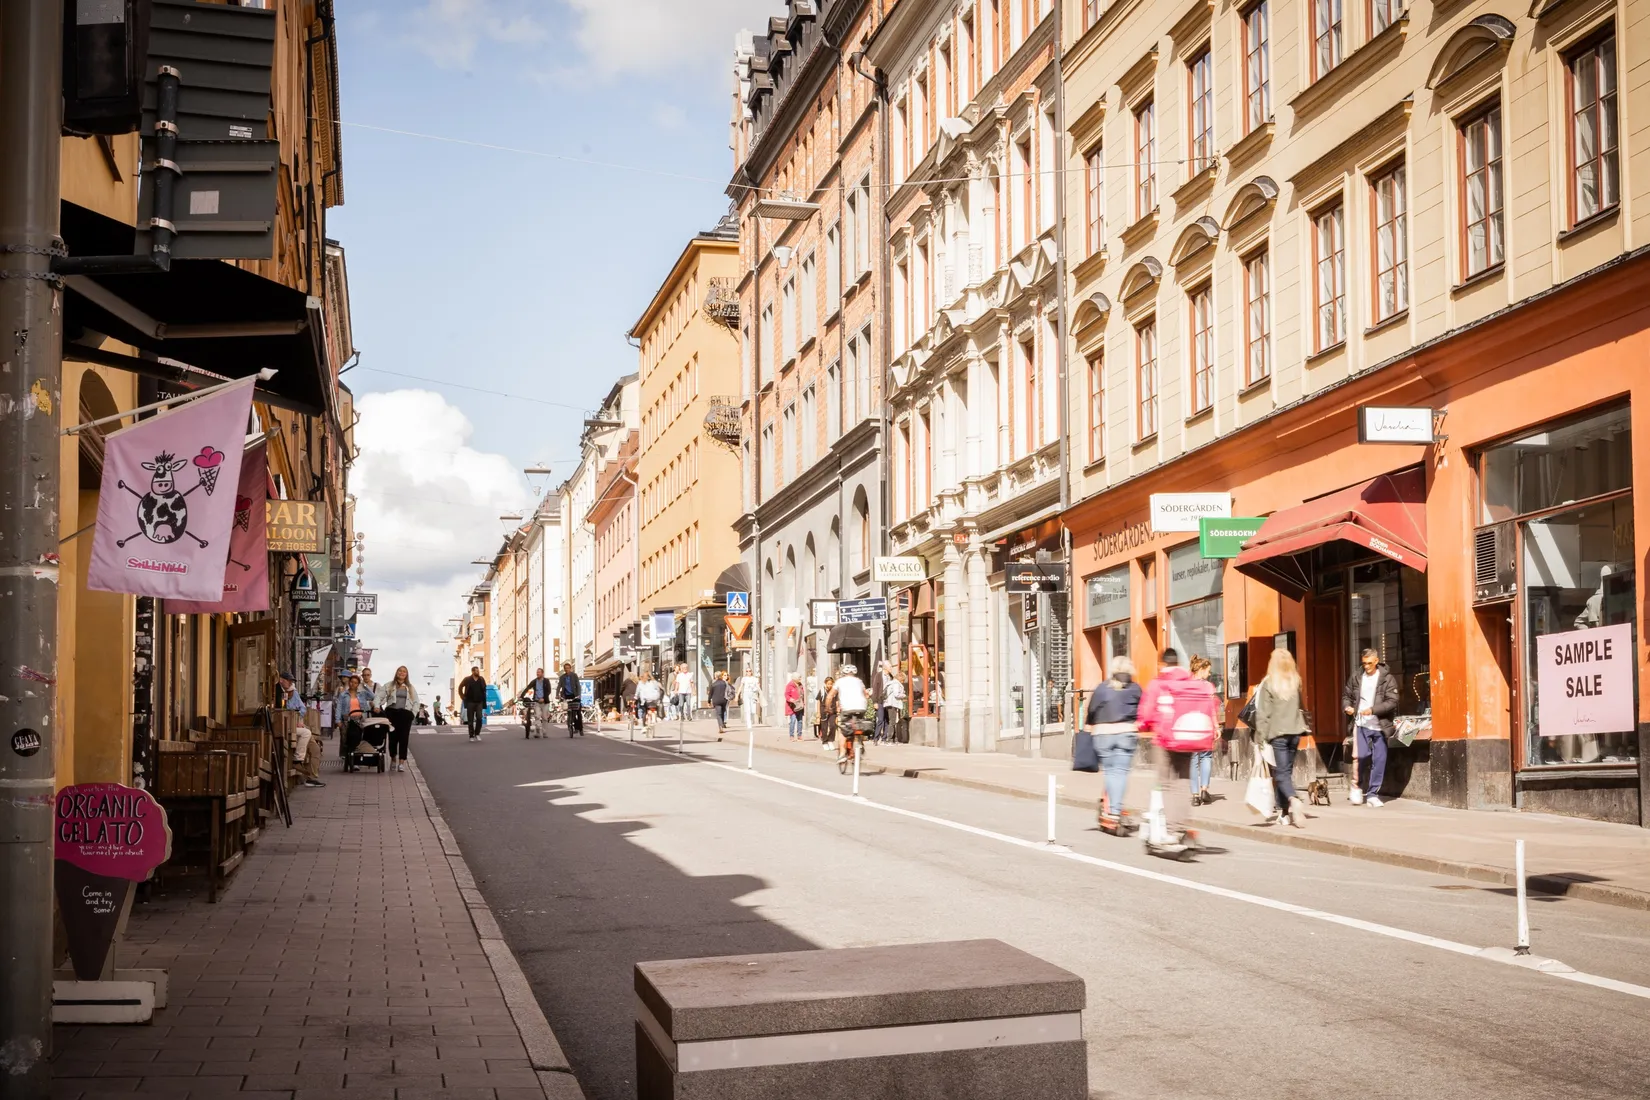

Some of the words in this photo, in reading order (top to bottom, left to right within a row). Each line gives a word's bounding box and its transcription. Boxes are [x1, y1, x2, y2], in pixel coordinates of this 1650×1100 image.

[1160, 503, 1223, 513] SÖDERGÅRDEN
[286, 543, 317, 551] HORSE
[879, 562, 921, 573] WACKO
[1555, 639, 1612, 666] SAMPLE
[1566, 674, 1602, 698] SALE
[58, 794, 147, 819] ORGANIC
[59, 820, 144, 845] GELATO
[82, 885, 103, 898] Come
[101, 898, 113, 907] try
[93, 905, 116, 914] some!
